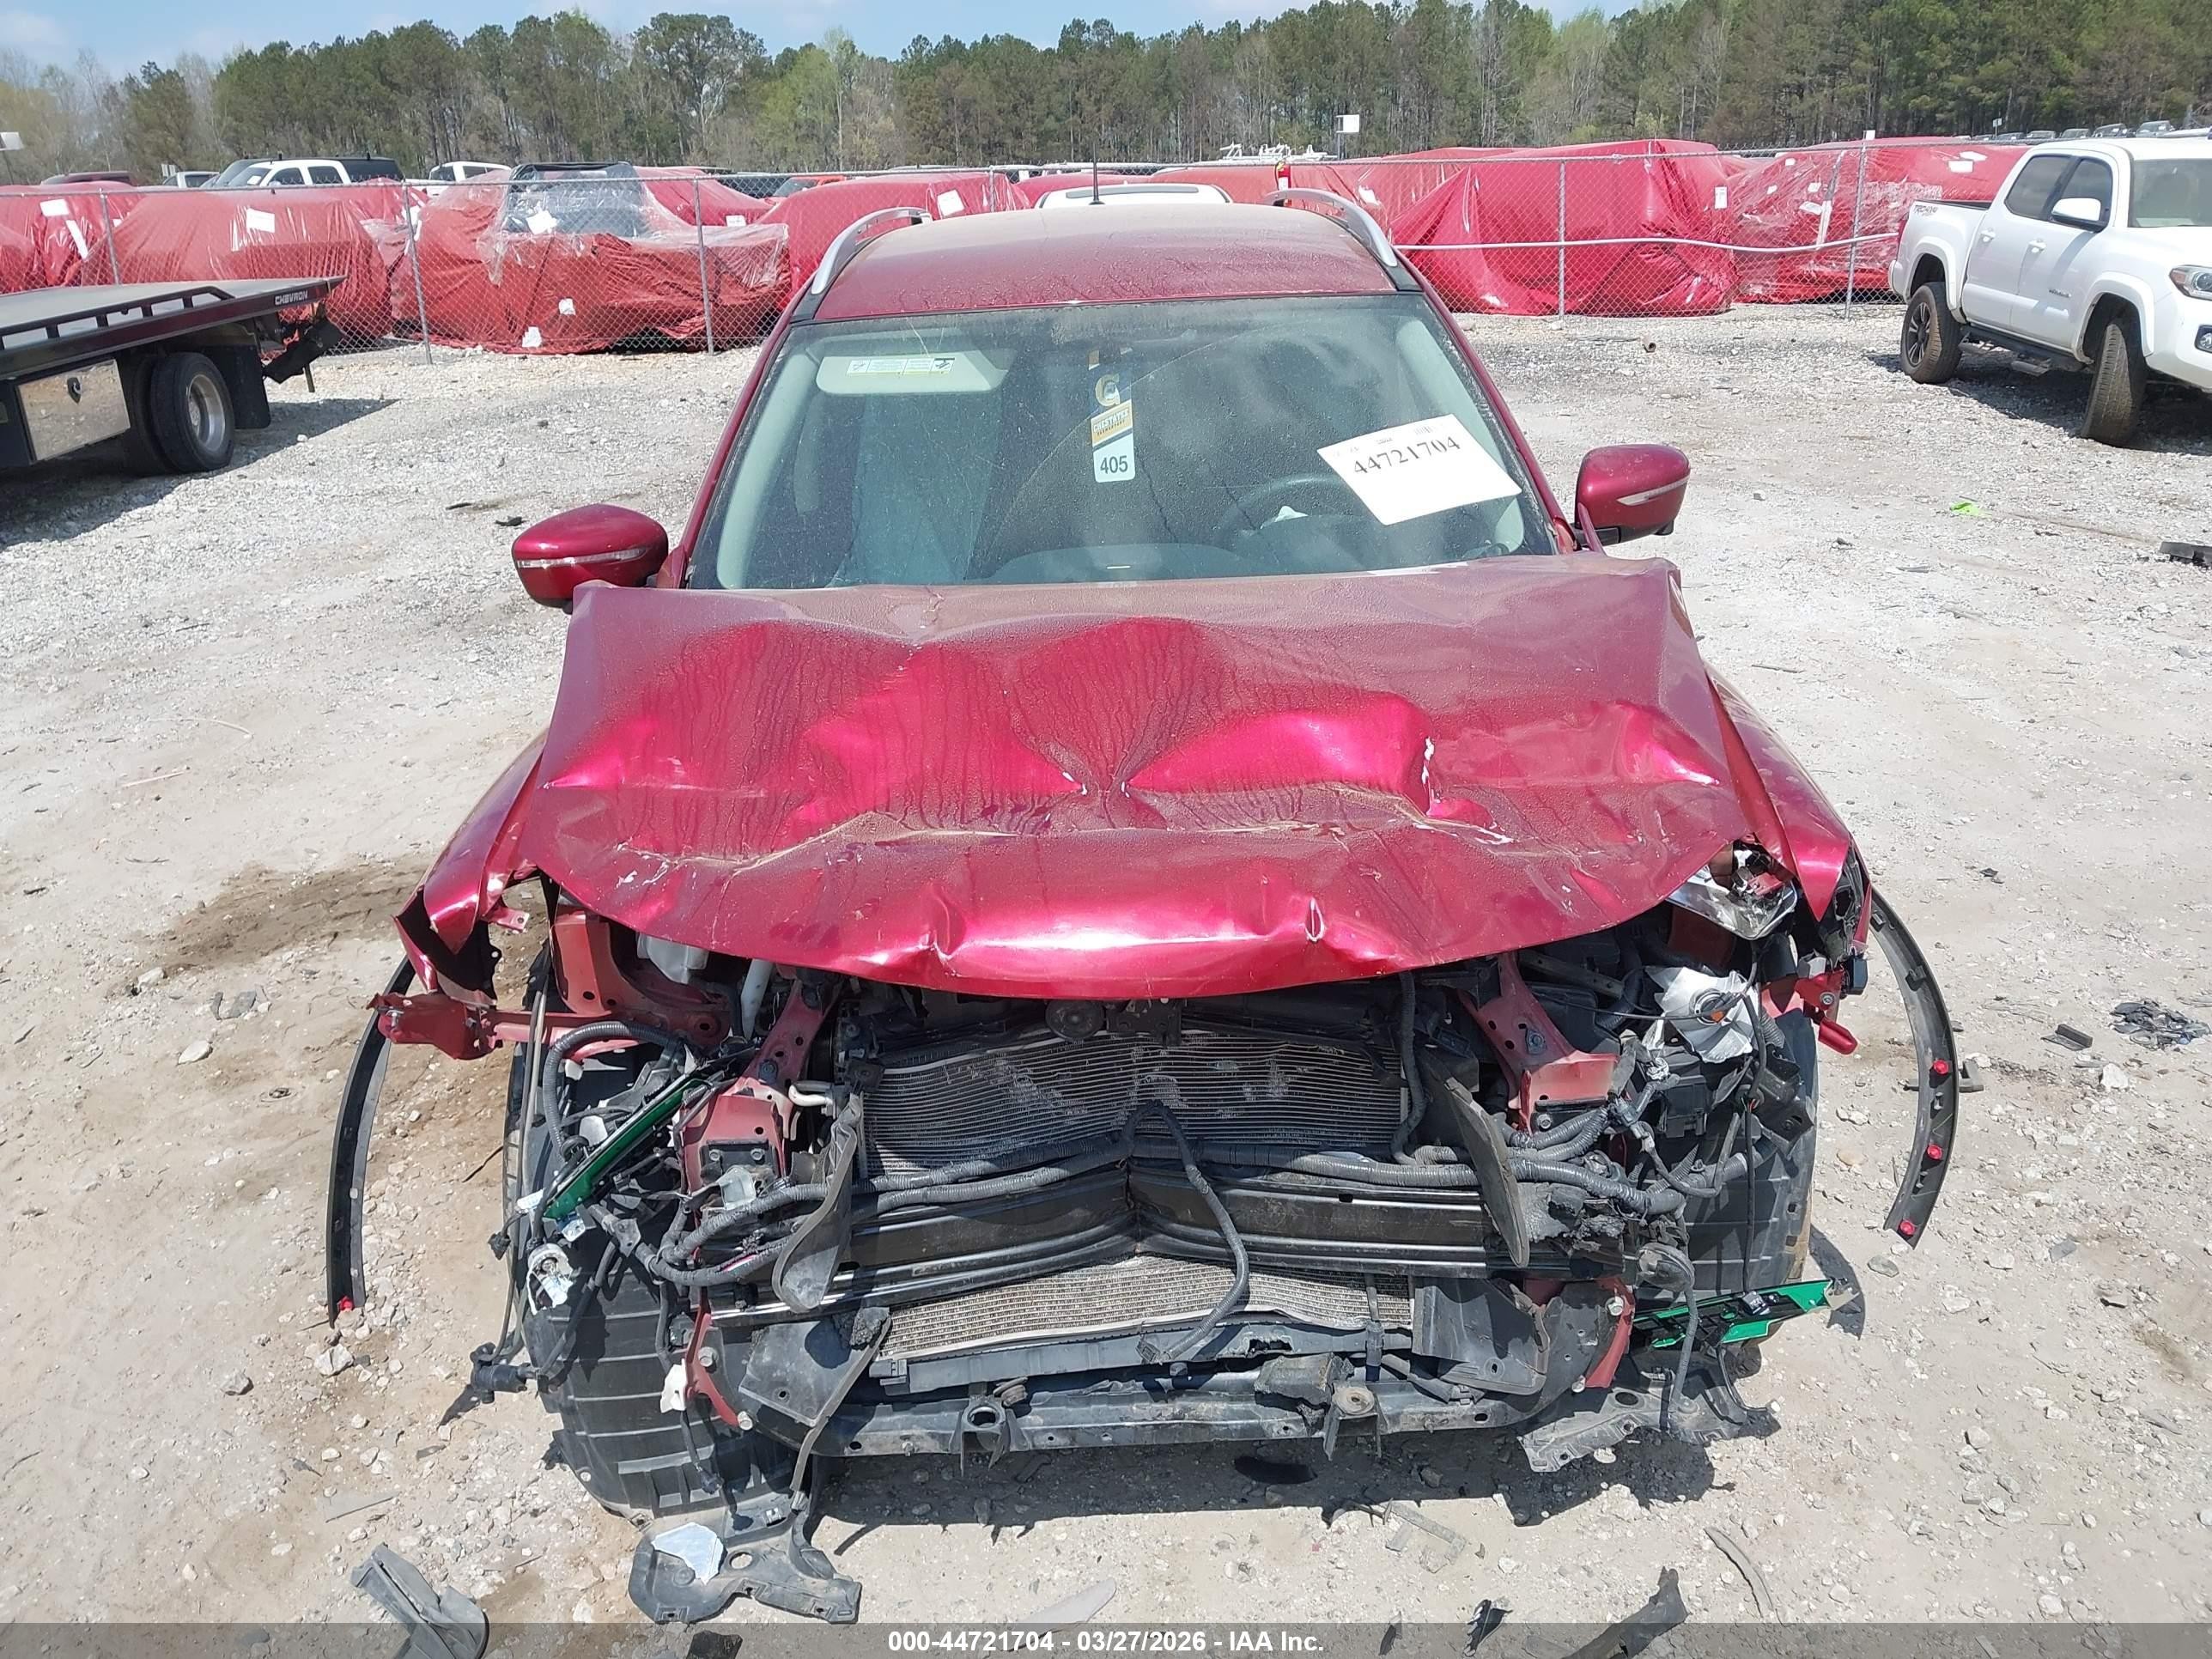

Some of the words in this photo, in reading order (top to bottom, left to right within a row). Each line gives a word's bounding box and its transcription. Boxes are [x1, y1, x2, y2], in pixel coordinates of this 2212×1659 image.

[275, 290, 308, 305] CHEVRON
[1353, 435, 1461, 473] 44721704
[1100, 455, 1128, 474] 405
